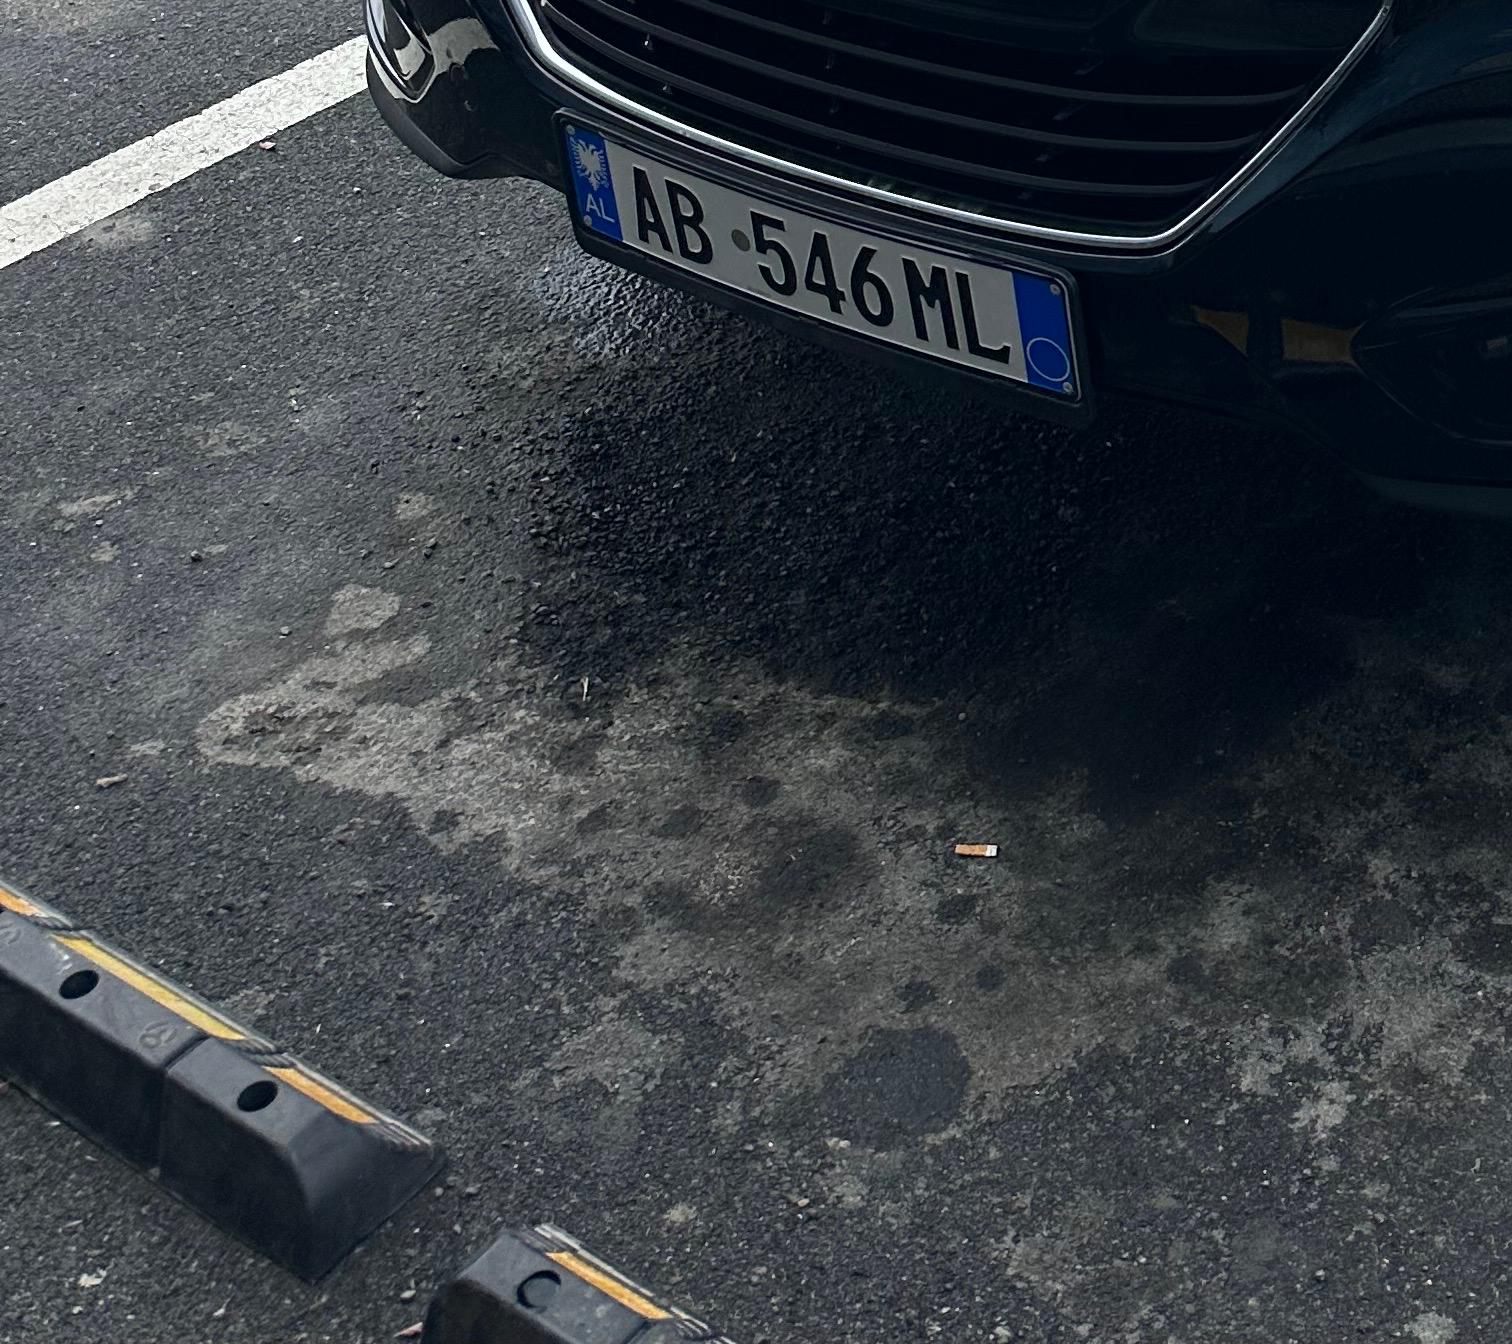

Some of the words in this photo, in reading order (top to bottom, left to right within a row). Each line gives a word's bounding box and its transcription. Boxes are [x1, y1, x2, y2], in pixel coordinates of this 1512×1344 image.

[584, 192, 615, 224] AL
[632, 164, 714, 266] AB
[749, 209, 894, 327] 546
[901, 255, 1011, 366] ML
